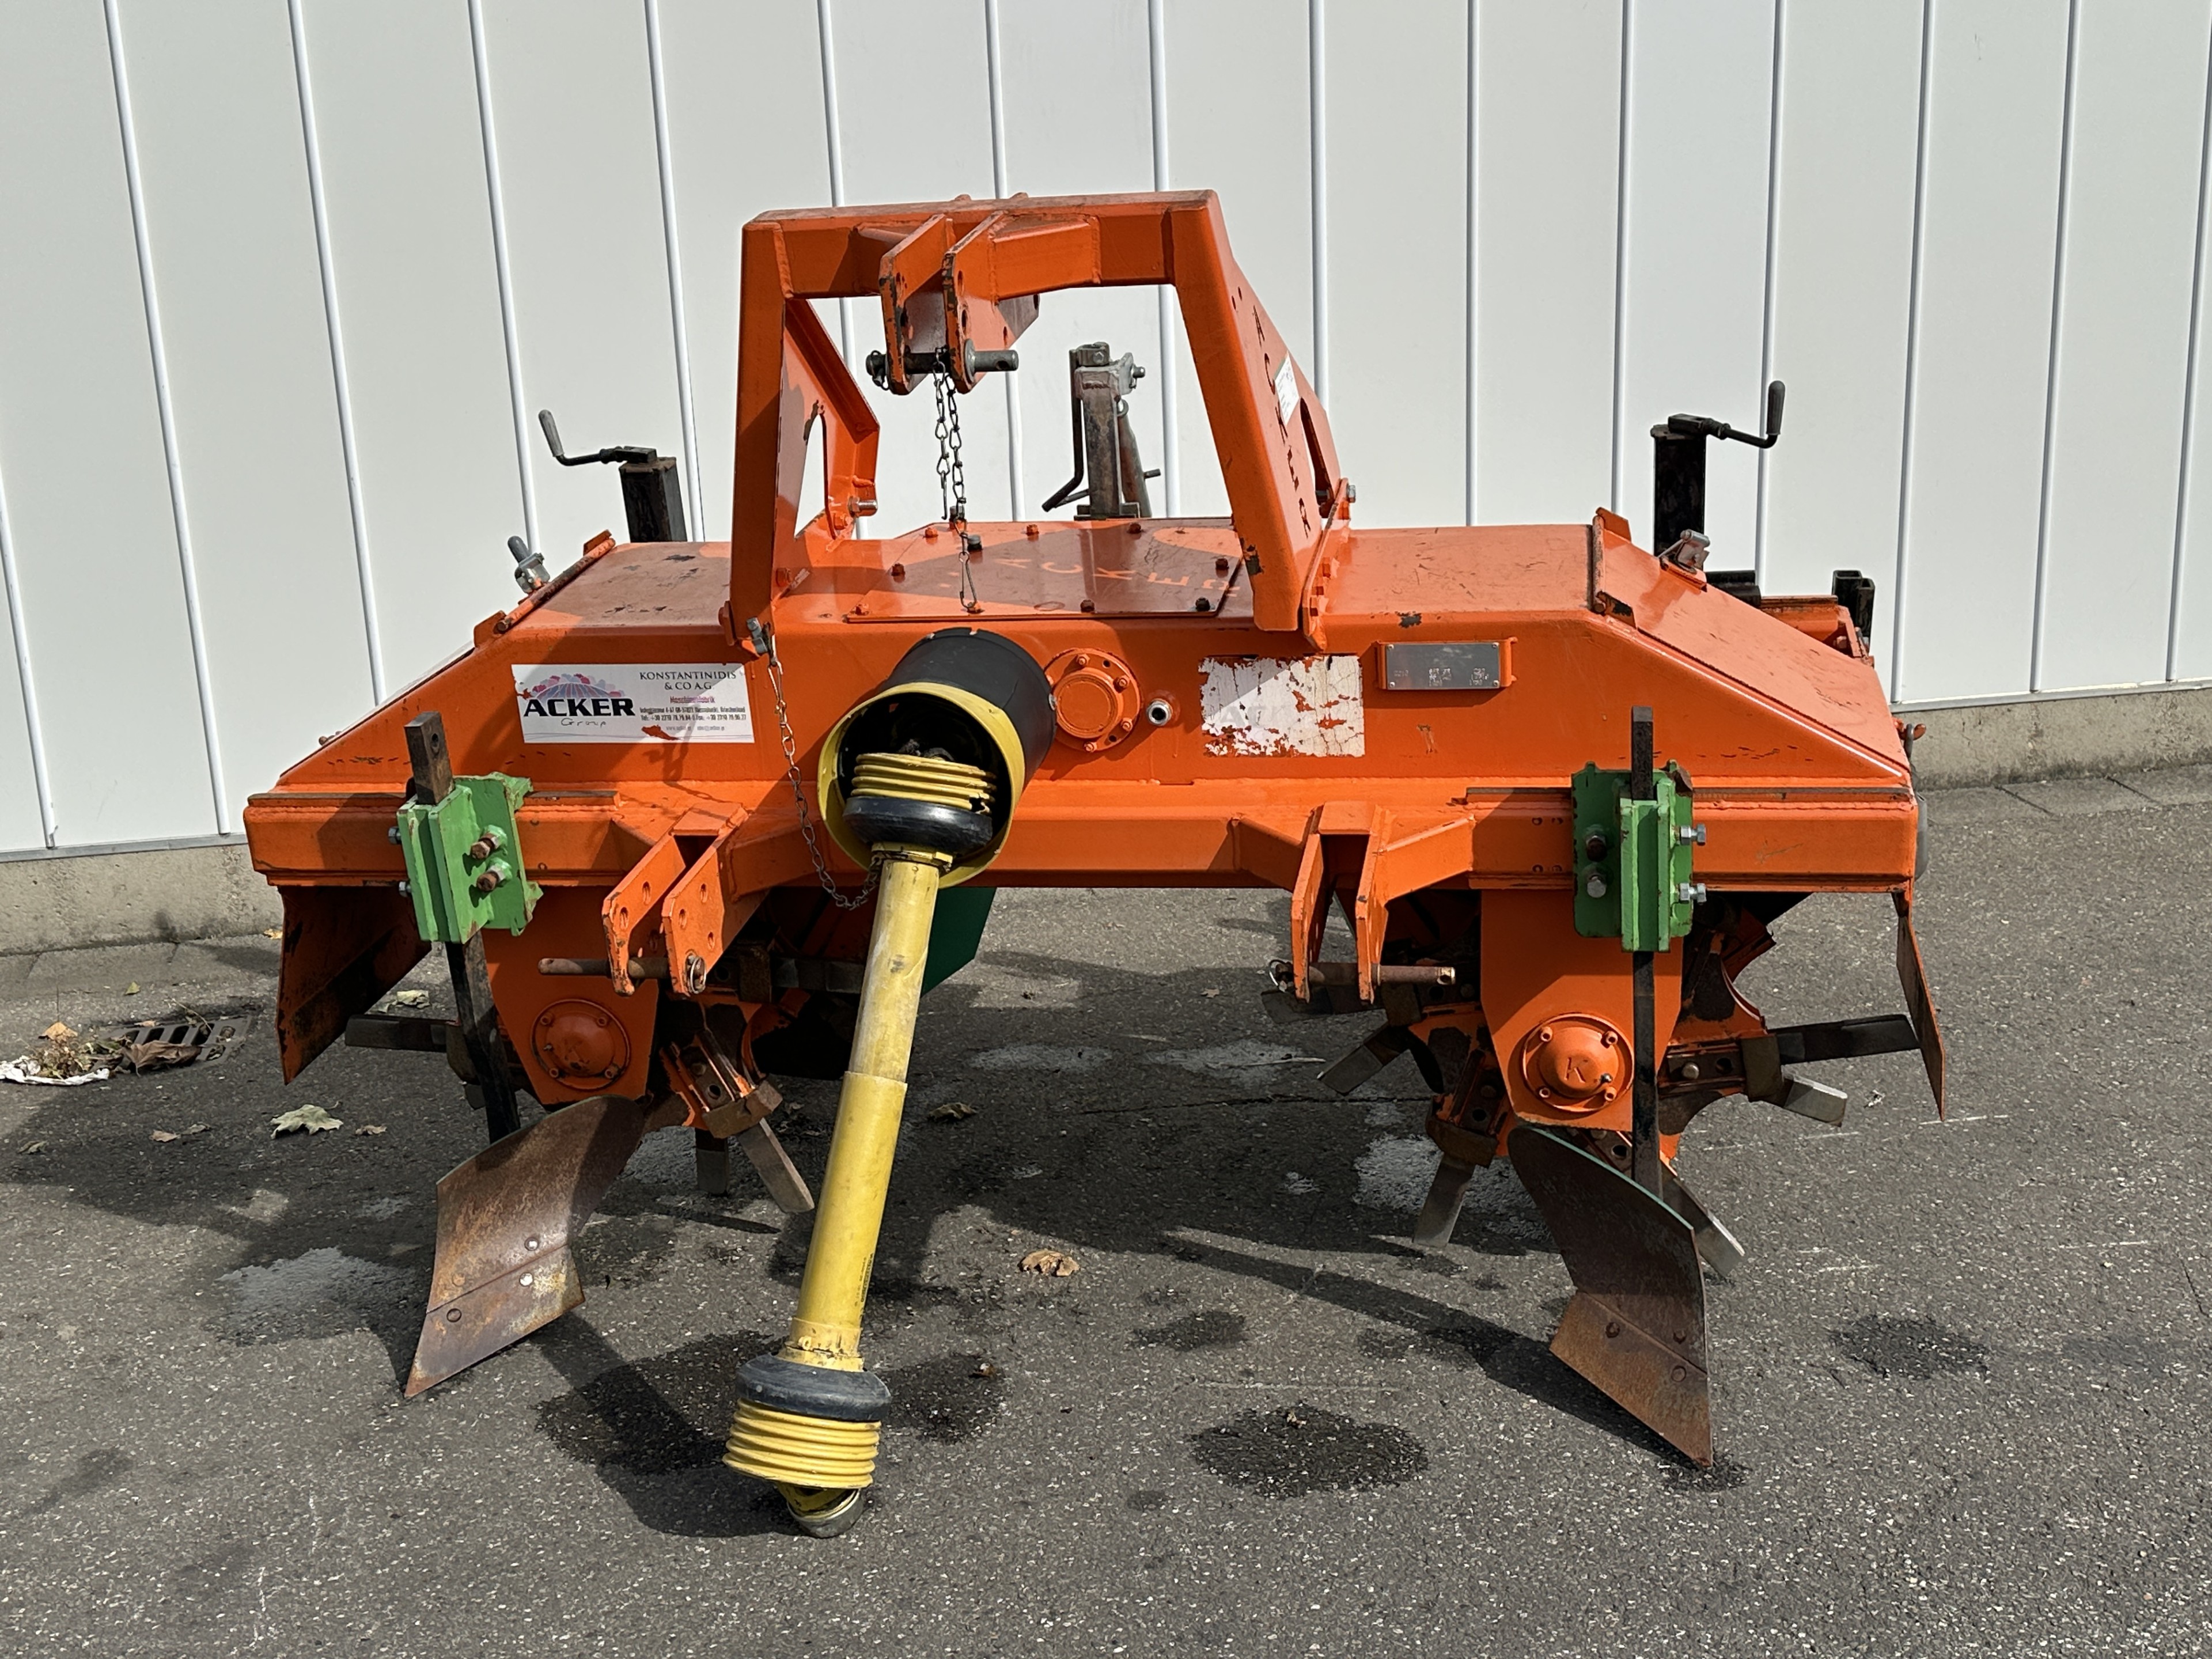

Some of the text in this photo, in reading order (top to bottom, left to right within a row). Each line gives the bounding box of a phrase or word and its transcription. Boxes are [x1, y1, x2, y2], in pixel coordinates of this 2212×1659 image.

[640, 671, 736, 680] KONSTANTINIDIS
[665, 682, 673, 690] &
[675, 682, 692, 690] CO
[524, 699, 635, 717] ACKER
[561, 718, 607, 728] Group
